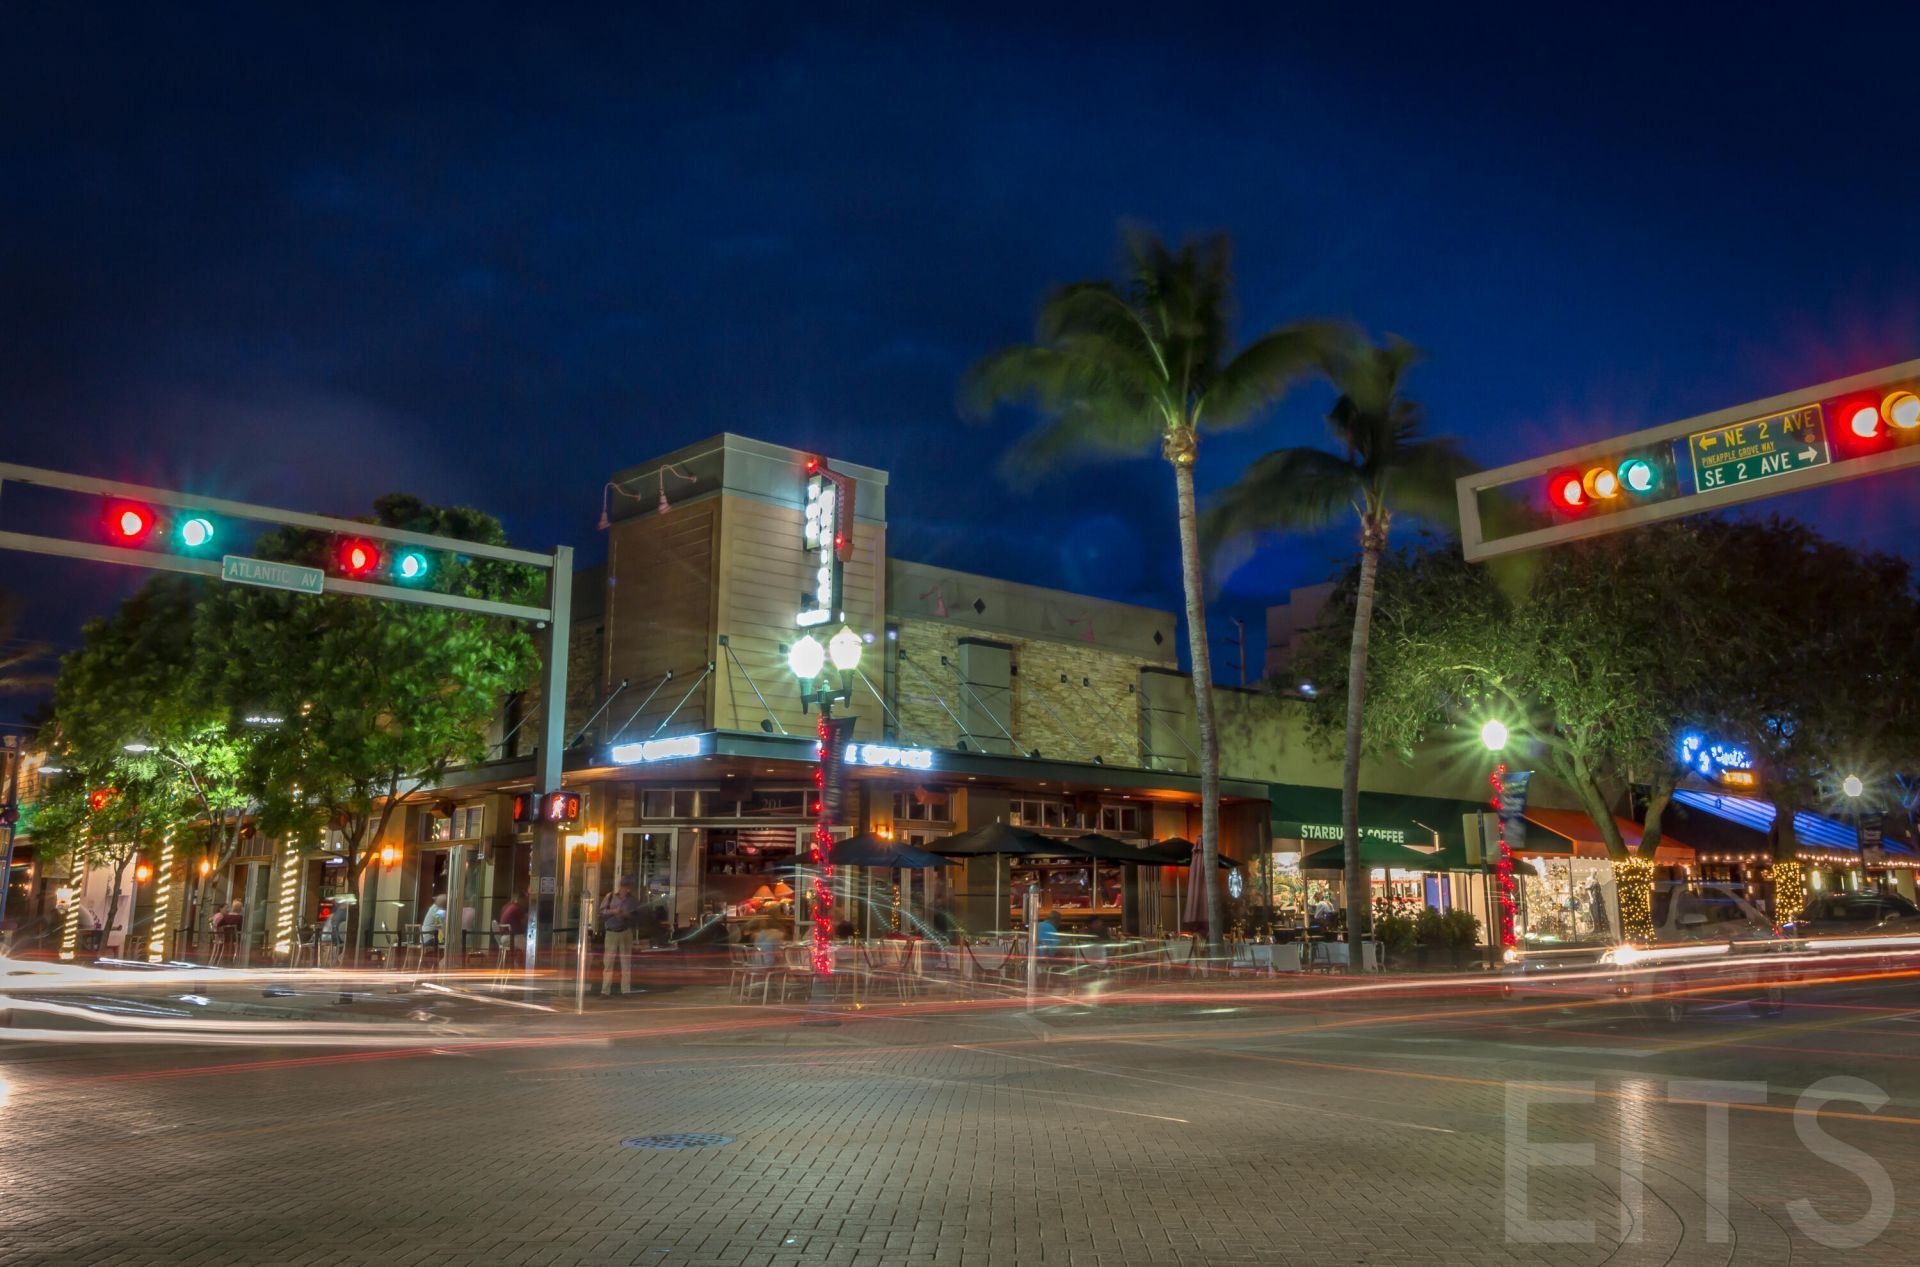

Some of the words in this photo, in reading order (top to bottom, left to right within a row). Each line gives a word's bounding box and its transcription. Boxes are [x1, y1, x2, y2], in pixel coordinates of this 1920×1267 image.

[1724, 427, 1746, 447] NE
[1758, 422, 1769, 440] 2
[1783, 411, 1814, 434] AVE
[1702, 449, 1736, 465] PINEAPPLE
[1739, 444, 1759, 458] GROVE
[1762, 440, 1775, 452] WAY
[1705, 468, 1725, 487] SE
[1737, 463, 1748, 480] 2
[1761, 452, 1791, 475] AVE
[229, 561, 289, 584] ATLANTIC
[301, 573, 317, 587] AV
[1301, 825, 1363, 841] STARBUS
